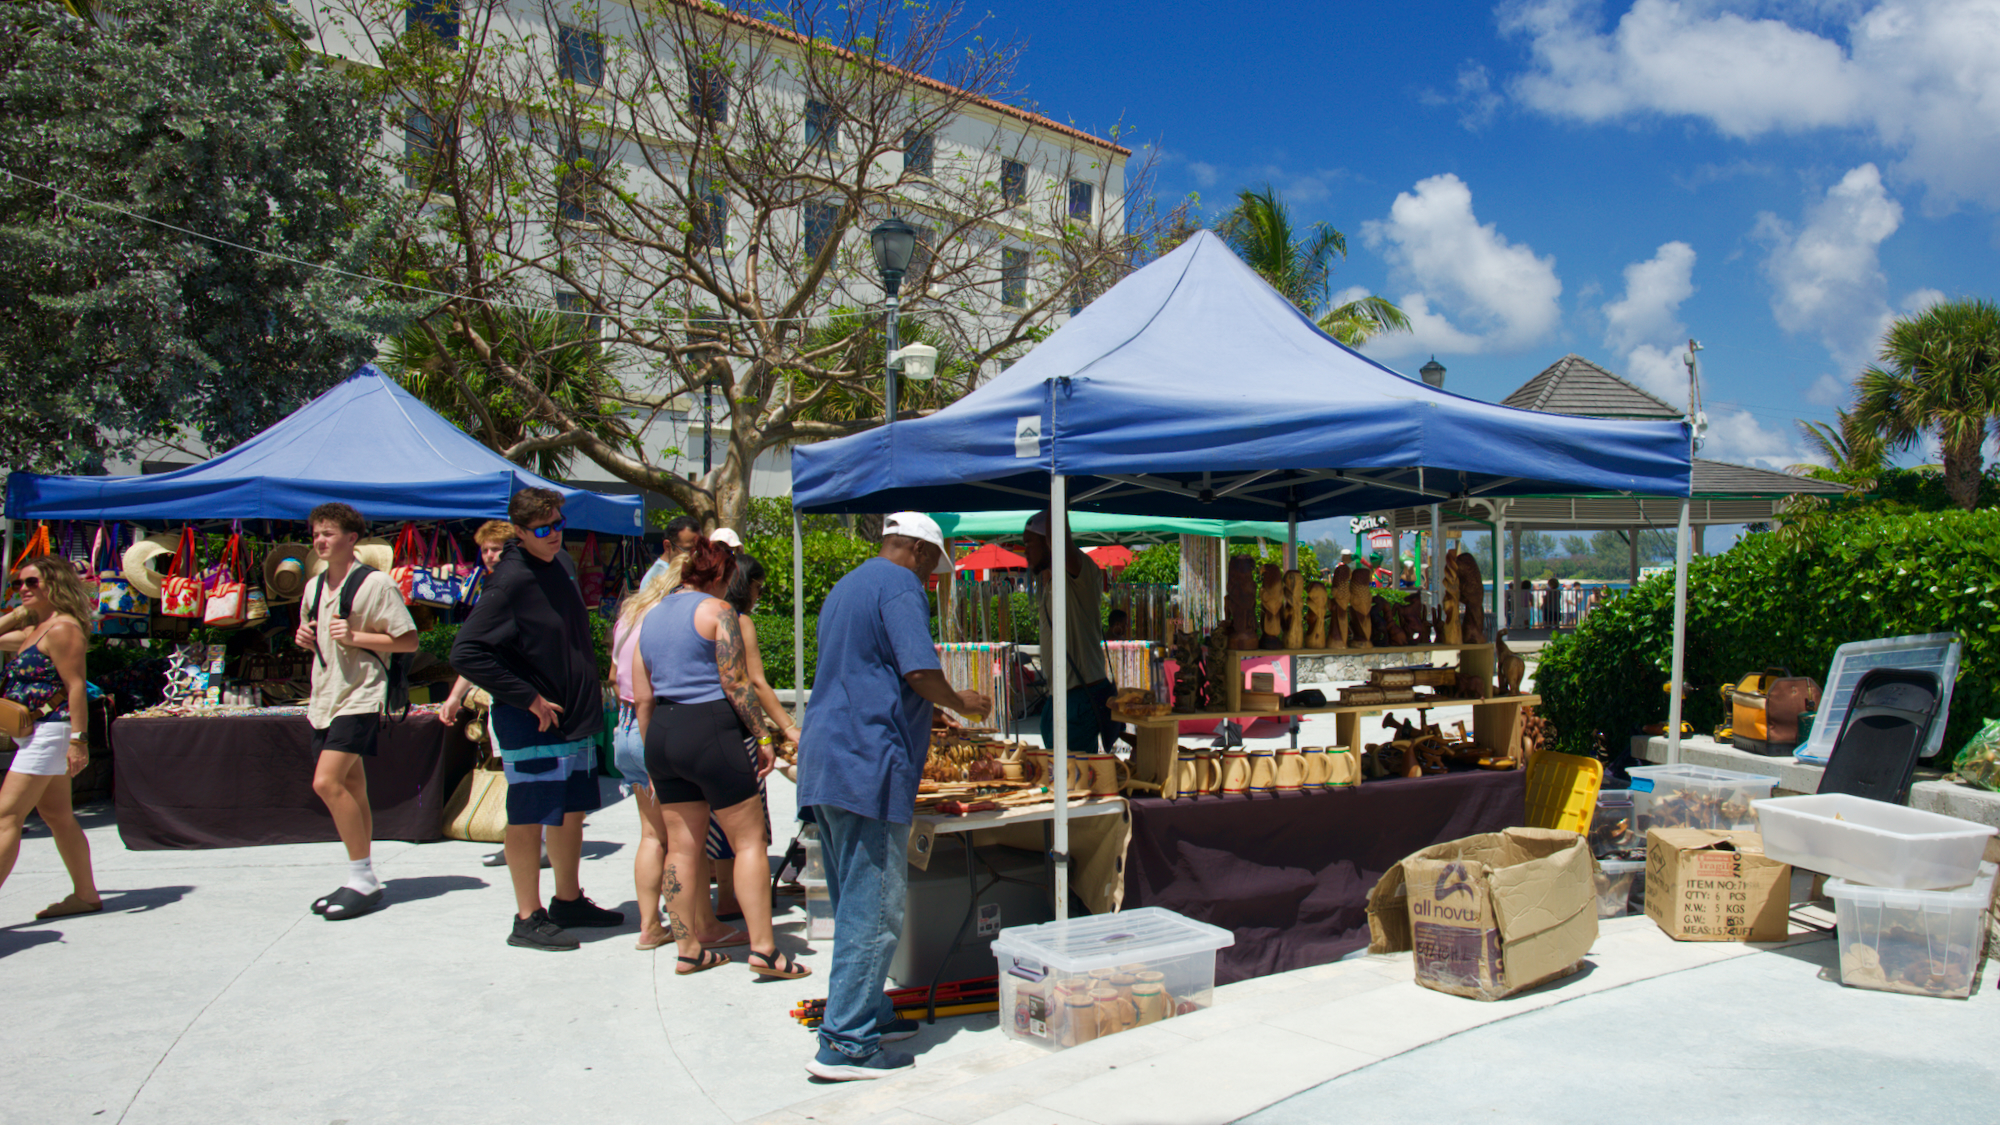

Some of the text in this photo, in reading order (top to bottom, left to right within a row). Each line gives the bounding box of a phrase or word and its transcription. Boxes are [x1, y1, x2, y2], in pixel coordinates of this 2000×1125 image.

[1686, 880, 1714, 889] ITEM
[1715, 892, 1720, 901] 6
[1729, 892, 1746, 901] PCS
[1413, 899, 1431, 916] all
[1715, 904, 1720, 913] 5
[1726, 904, 1745, 914] KGS
[1716, 915, 1721, 923] 7
